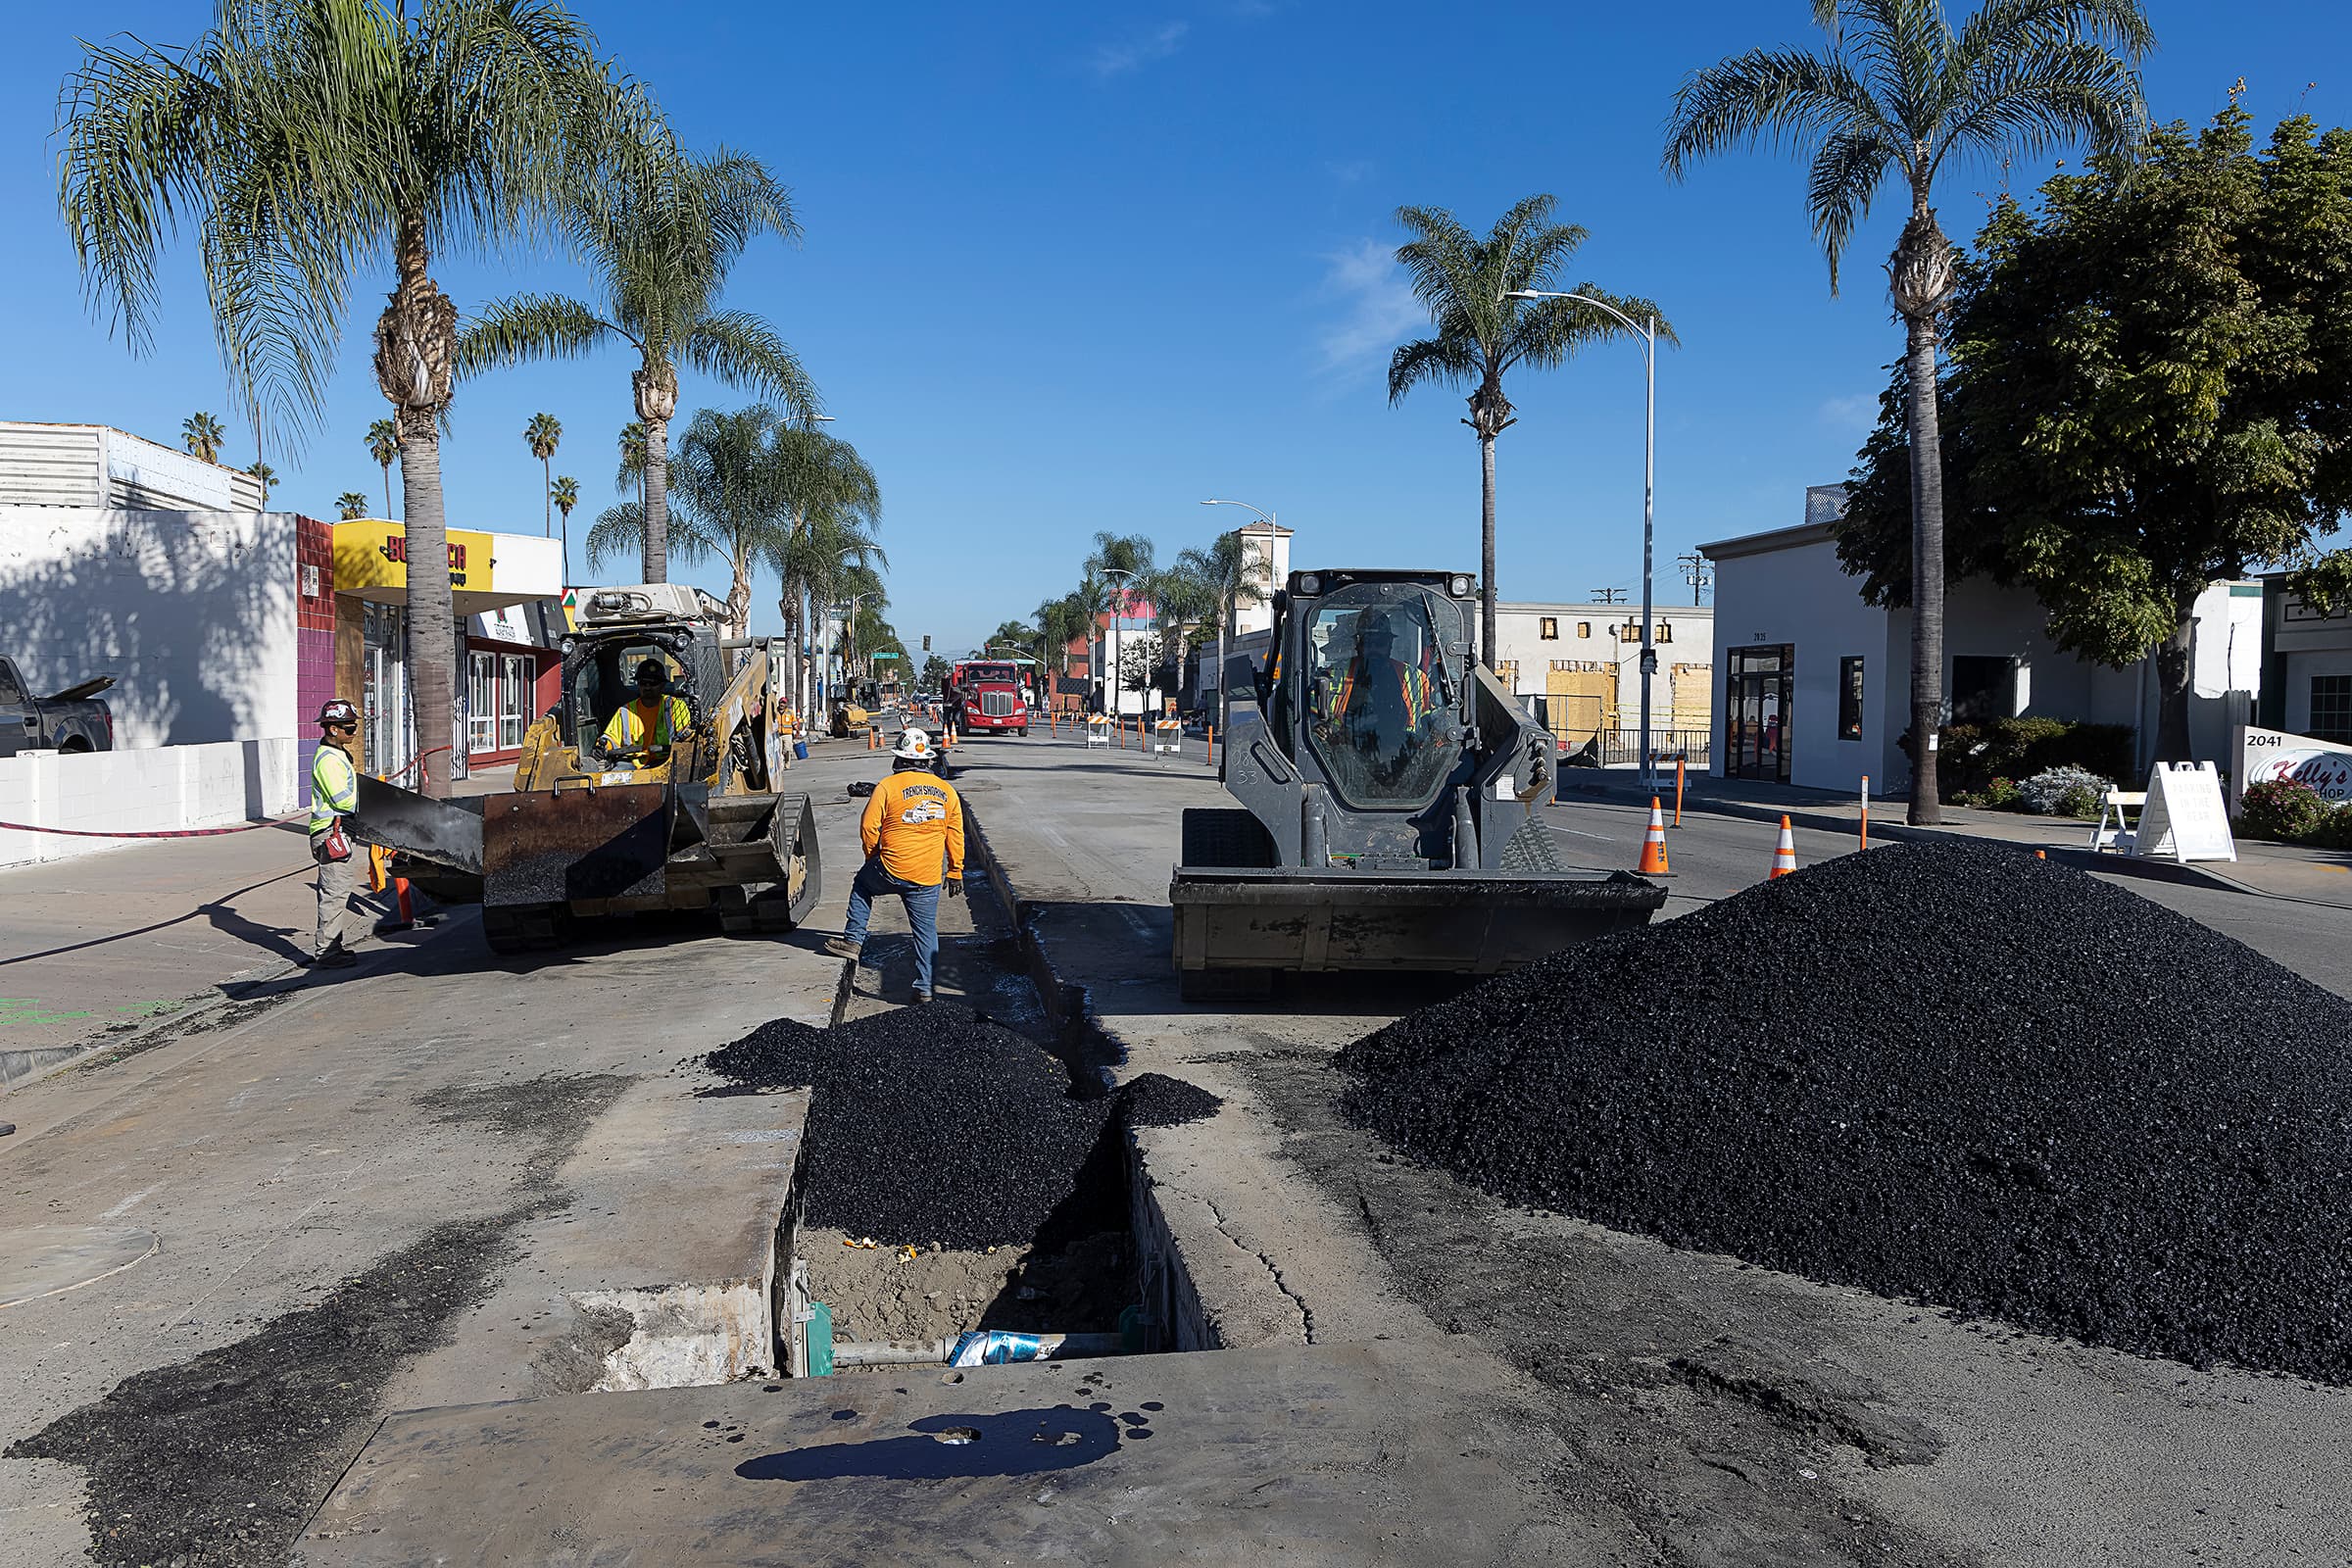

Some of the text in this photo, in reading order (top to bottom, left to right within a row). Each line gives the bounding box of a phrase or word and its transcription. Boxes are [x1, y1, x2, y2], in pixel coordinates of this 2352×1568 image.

[2247, 735, 2281, 747] 2041
[2273, 760, 2348, 791] Kelly's
[902, 785, 948, 803] TRENCH SHORING
[2315, 788, 2345, 799] HOP
